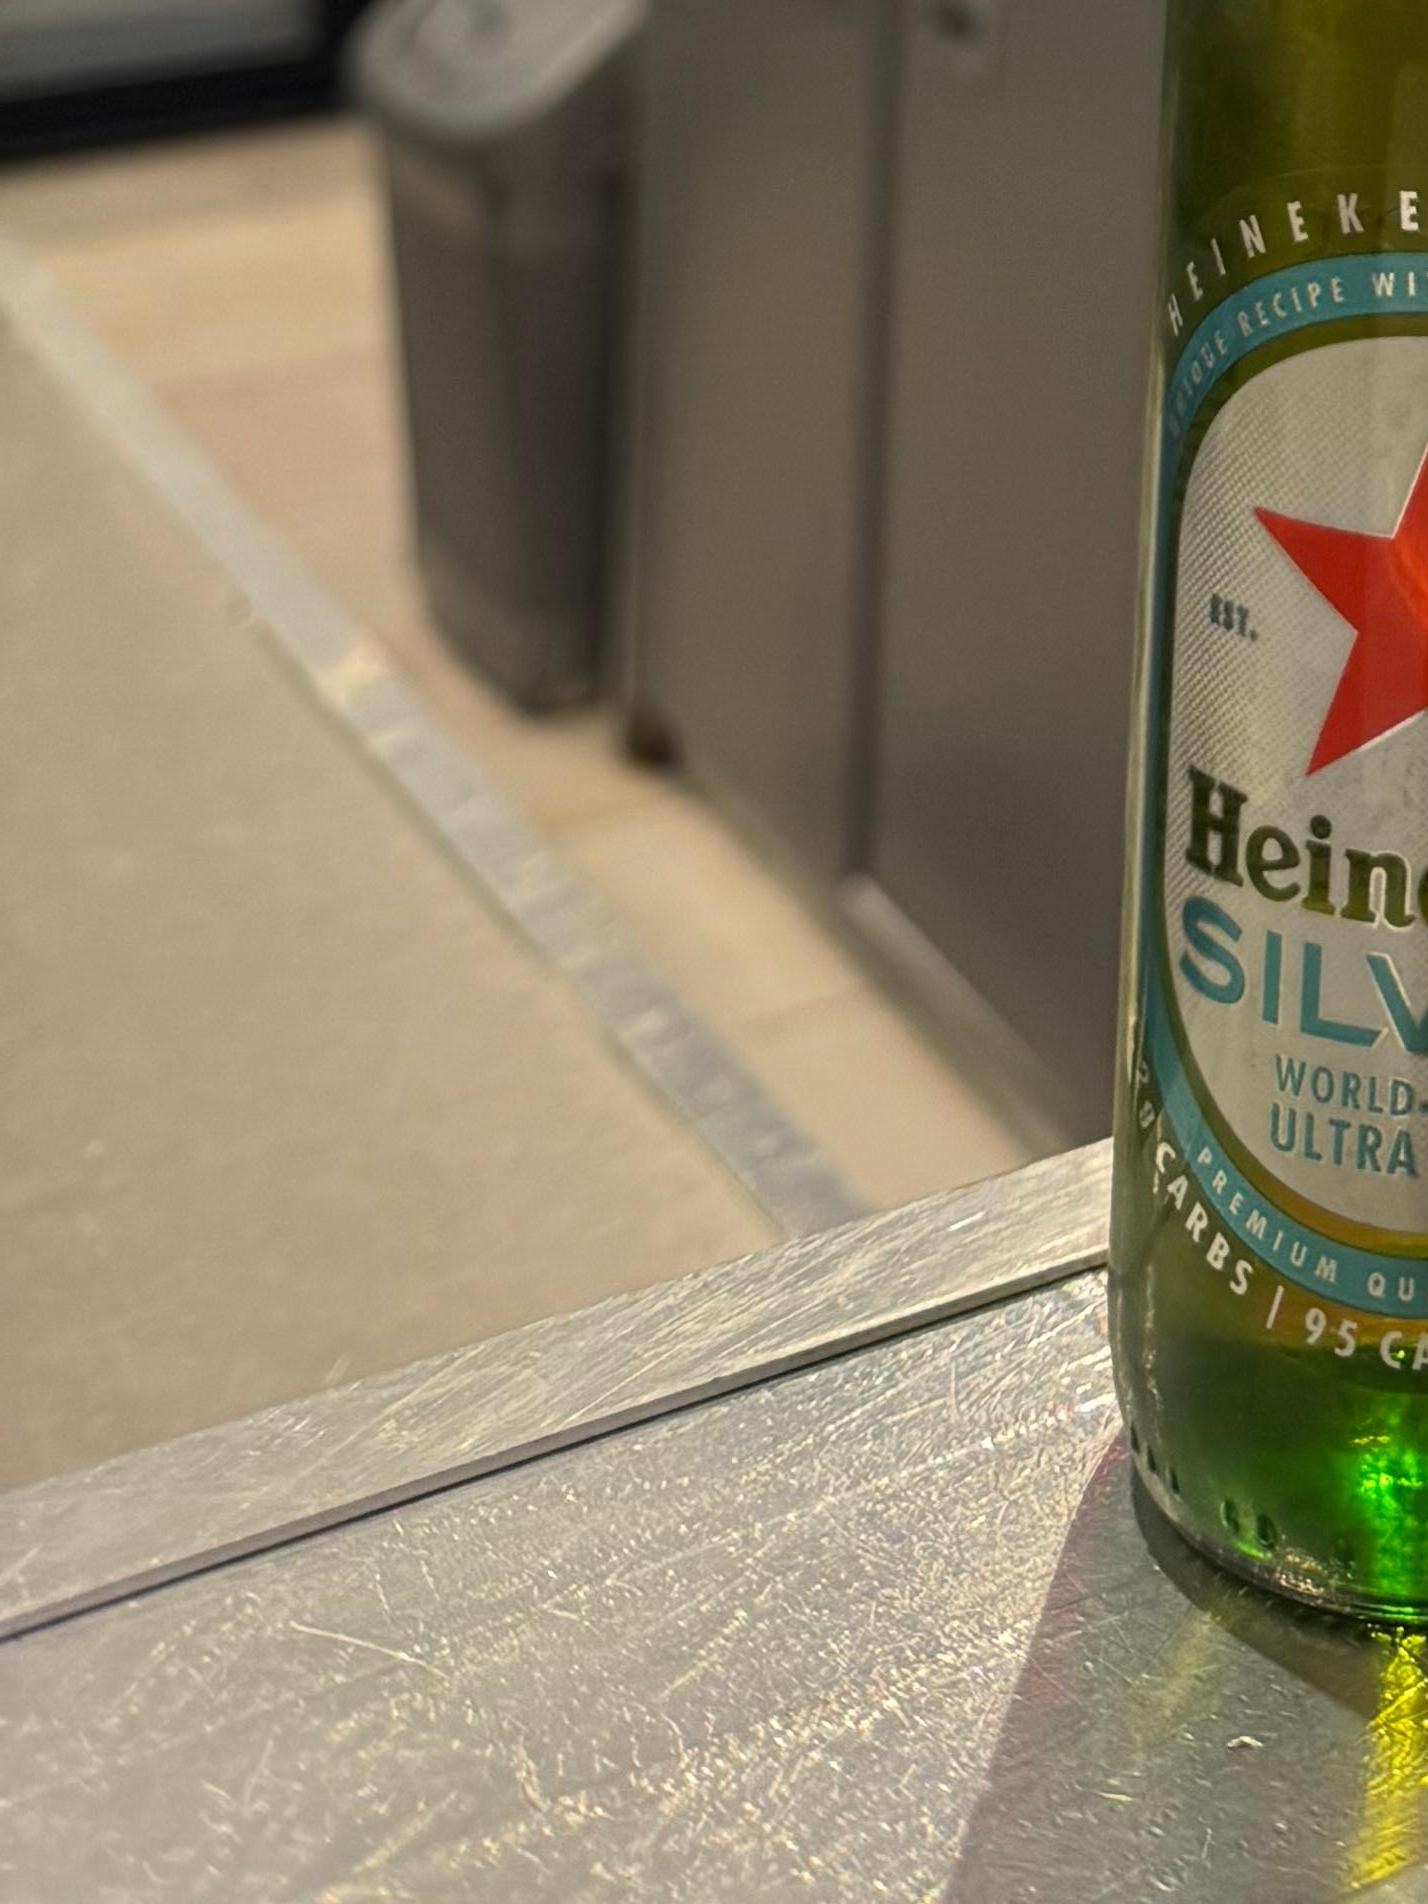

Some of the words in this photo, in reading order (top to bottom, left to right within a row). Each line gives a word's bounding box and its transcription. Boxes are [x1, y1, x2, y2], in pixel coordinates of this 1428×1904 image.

[1237, 276, 1345, 337] RECIPE
[1270, 1103, 1419, 1179] ULTRA
[1155, 1141, 1254, 1296] CARBS
[1304, 1307, 1358, 1357] 95
[1197, 1146, 1338, 1284] PREMIUM
